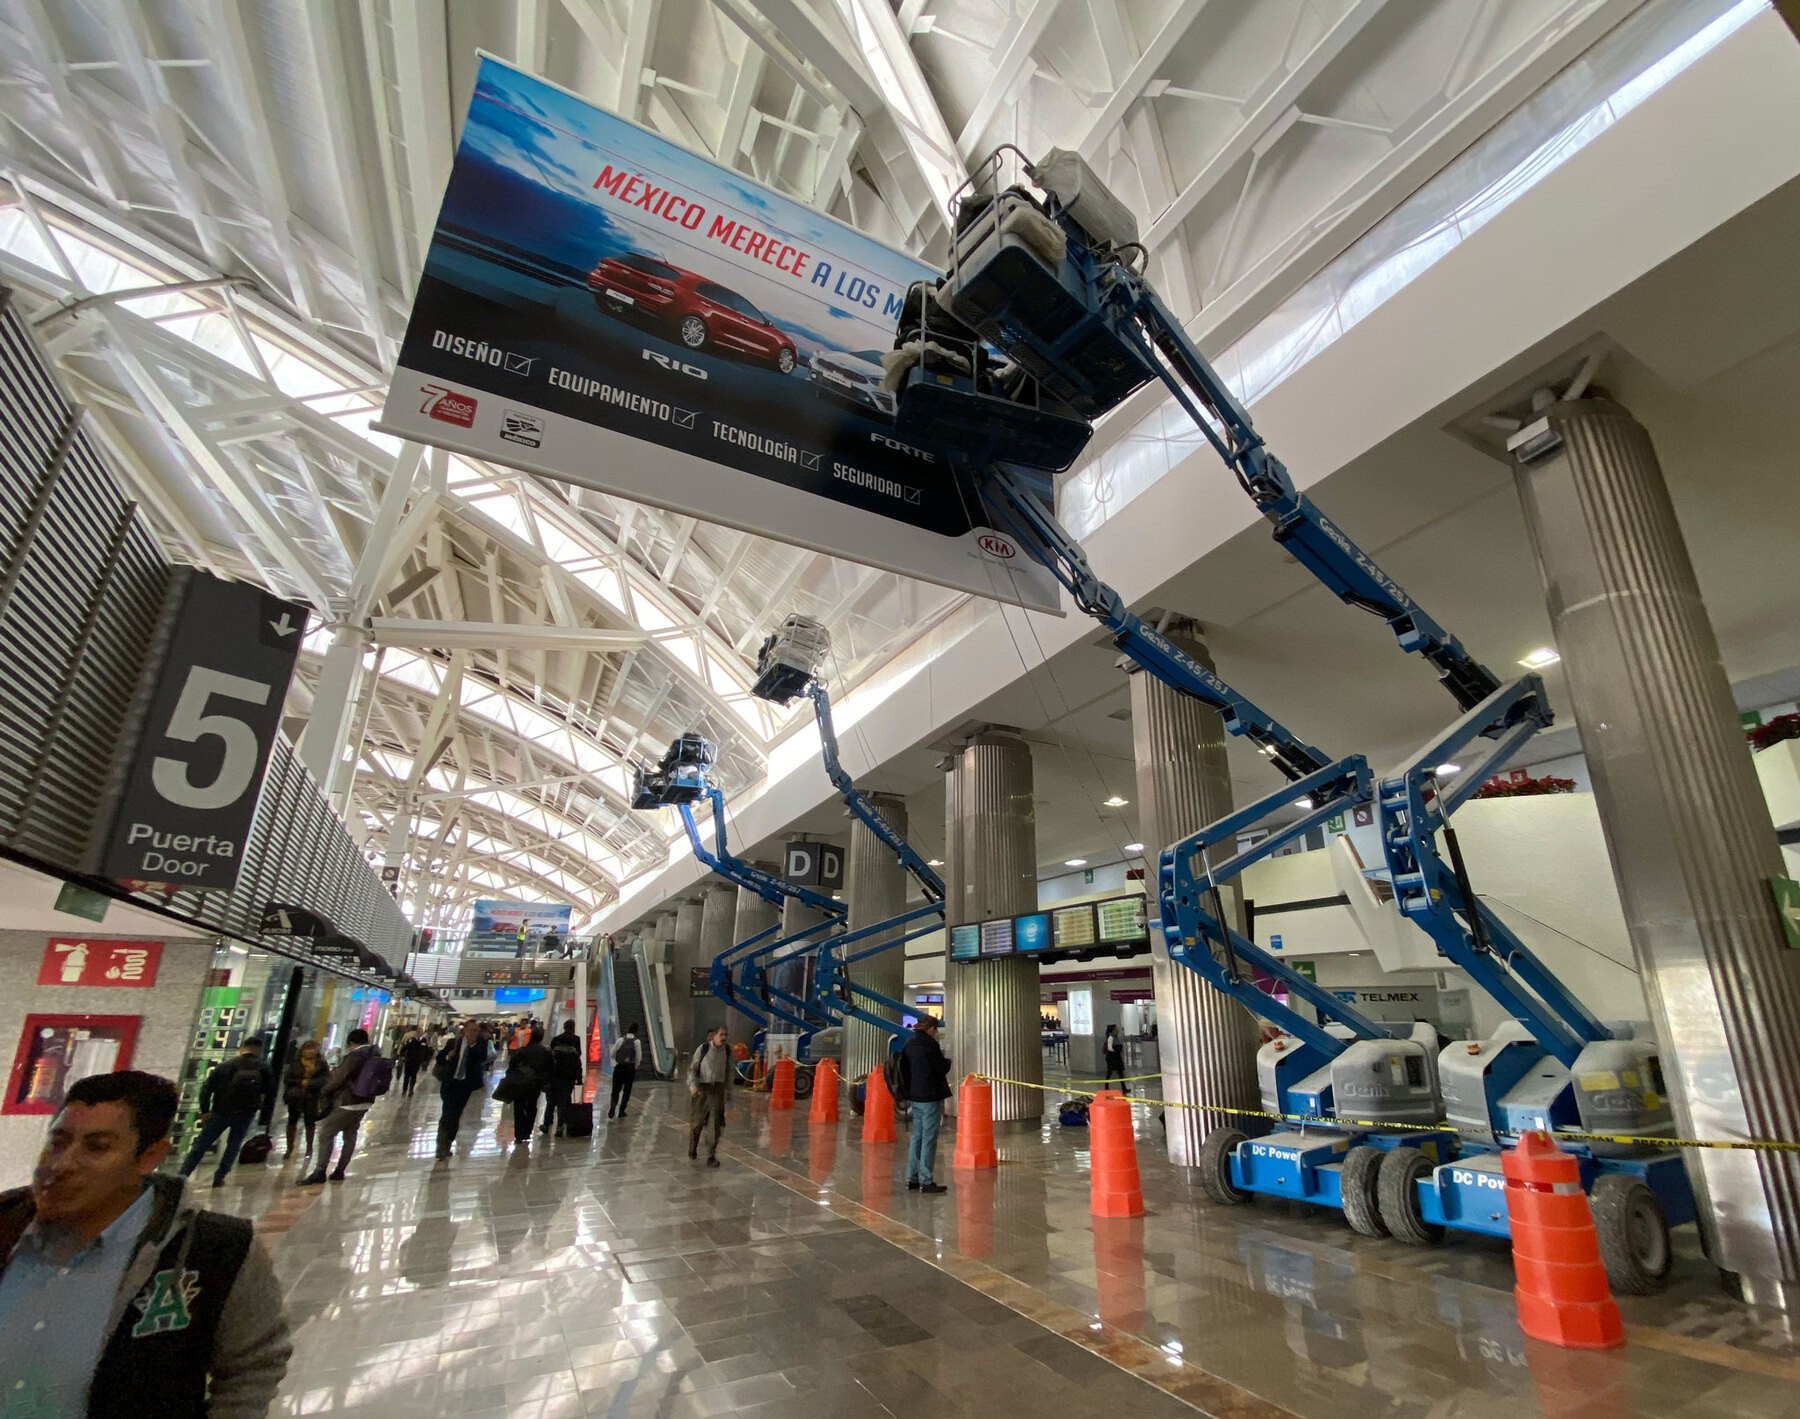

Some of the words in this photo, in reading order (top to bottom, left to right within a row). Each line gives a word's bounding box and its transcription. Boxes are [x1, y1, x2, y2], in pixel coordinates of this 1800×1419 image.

[593, 165, 706, 230] MÉXICO
[707, 215, 811, 278] MERECE
[811, 262, 832, 288] A
[834, 271, 881, 309] LOS
[432, 330, 502, 367] DISEÑO
[642, 349, 708, 380] RIO
[420, 384, 449, 414] 7
[438, 398, 473, 414] AÑOS
[548, 367, 670, 421] EQUIPAMIENTO
[713, 421, 797, 463] TECNOLOGÍA
[871, 433, 935, 463] FORTE
[833, 462, 902, 498] SEGURIDAD
[984, 537, 1011, 556] KIA
[1140, 625, 1171, 653] Genie
[152, 664, 272, 809] 5
[127, 823, 235, 858] Puerta
[142, 852, 210, 876] Door
[789, 850, 811, 877] D
[824, 852, 839, 879] D
[1360, 993, 1420, 1002] TELMEX
[1252, 1144, 1266, 1156] DC
[1269, 1147, 1298, 1161] Powe
[1453, 1170, 1473, 1185] DC
